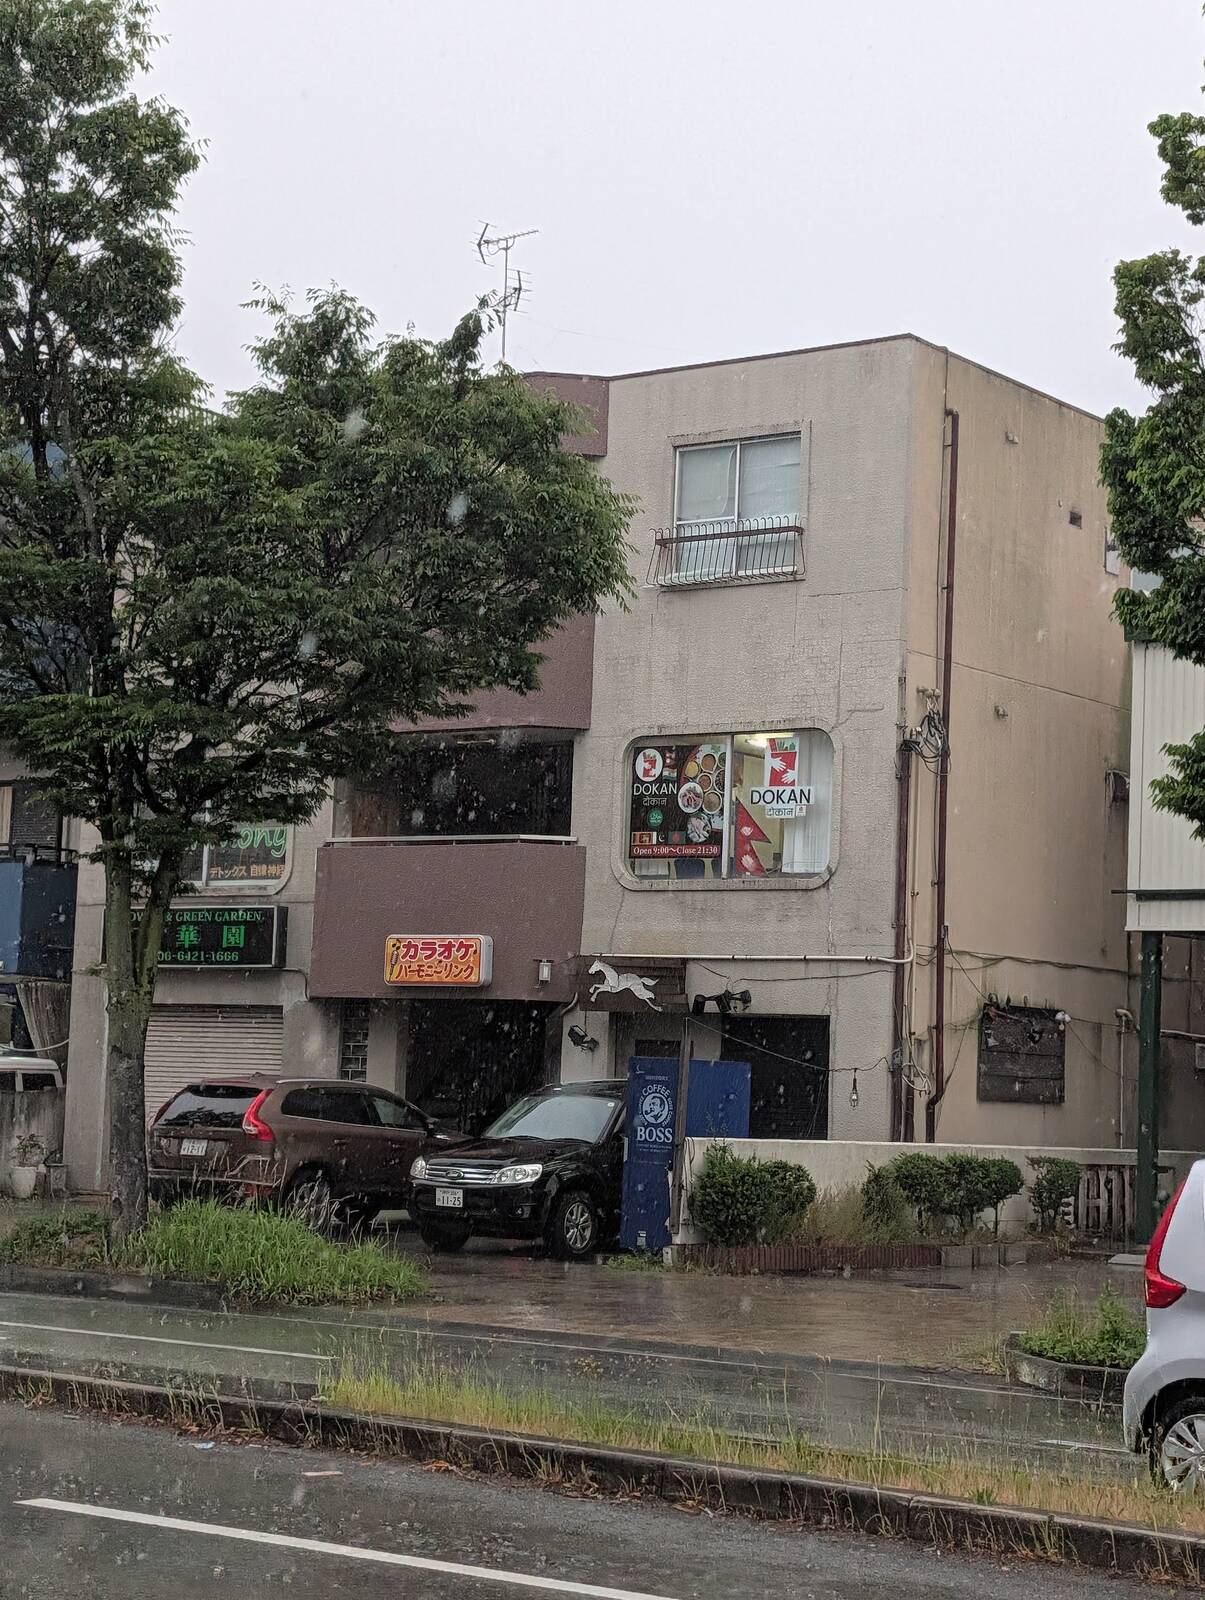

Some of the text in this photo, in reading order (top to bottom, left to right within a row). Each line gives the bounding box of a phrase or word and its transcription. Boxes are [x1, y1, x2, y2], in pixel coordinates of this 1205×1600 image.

[633, 782, 678, 796] DOKAN
[750, 788, 811, 805] DOKAN
[633, 846, 652, 856] Open
[697, 846, 718, 855] 21:30
[209, 865, 248, 878] デトックス
[176, 911, 212, 922] GREEN
[400, 939, 475, 961] カラオケ
[642, 1084, 671, 1098] COFFEE
[636, 1126, 673, 1143] BOSS
